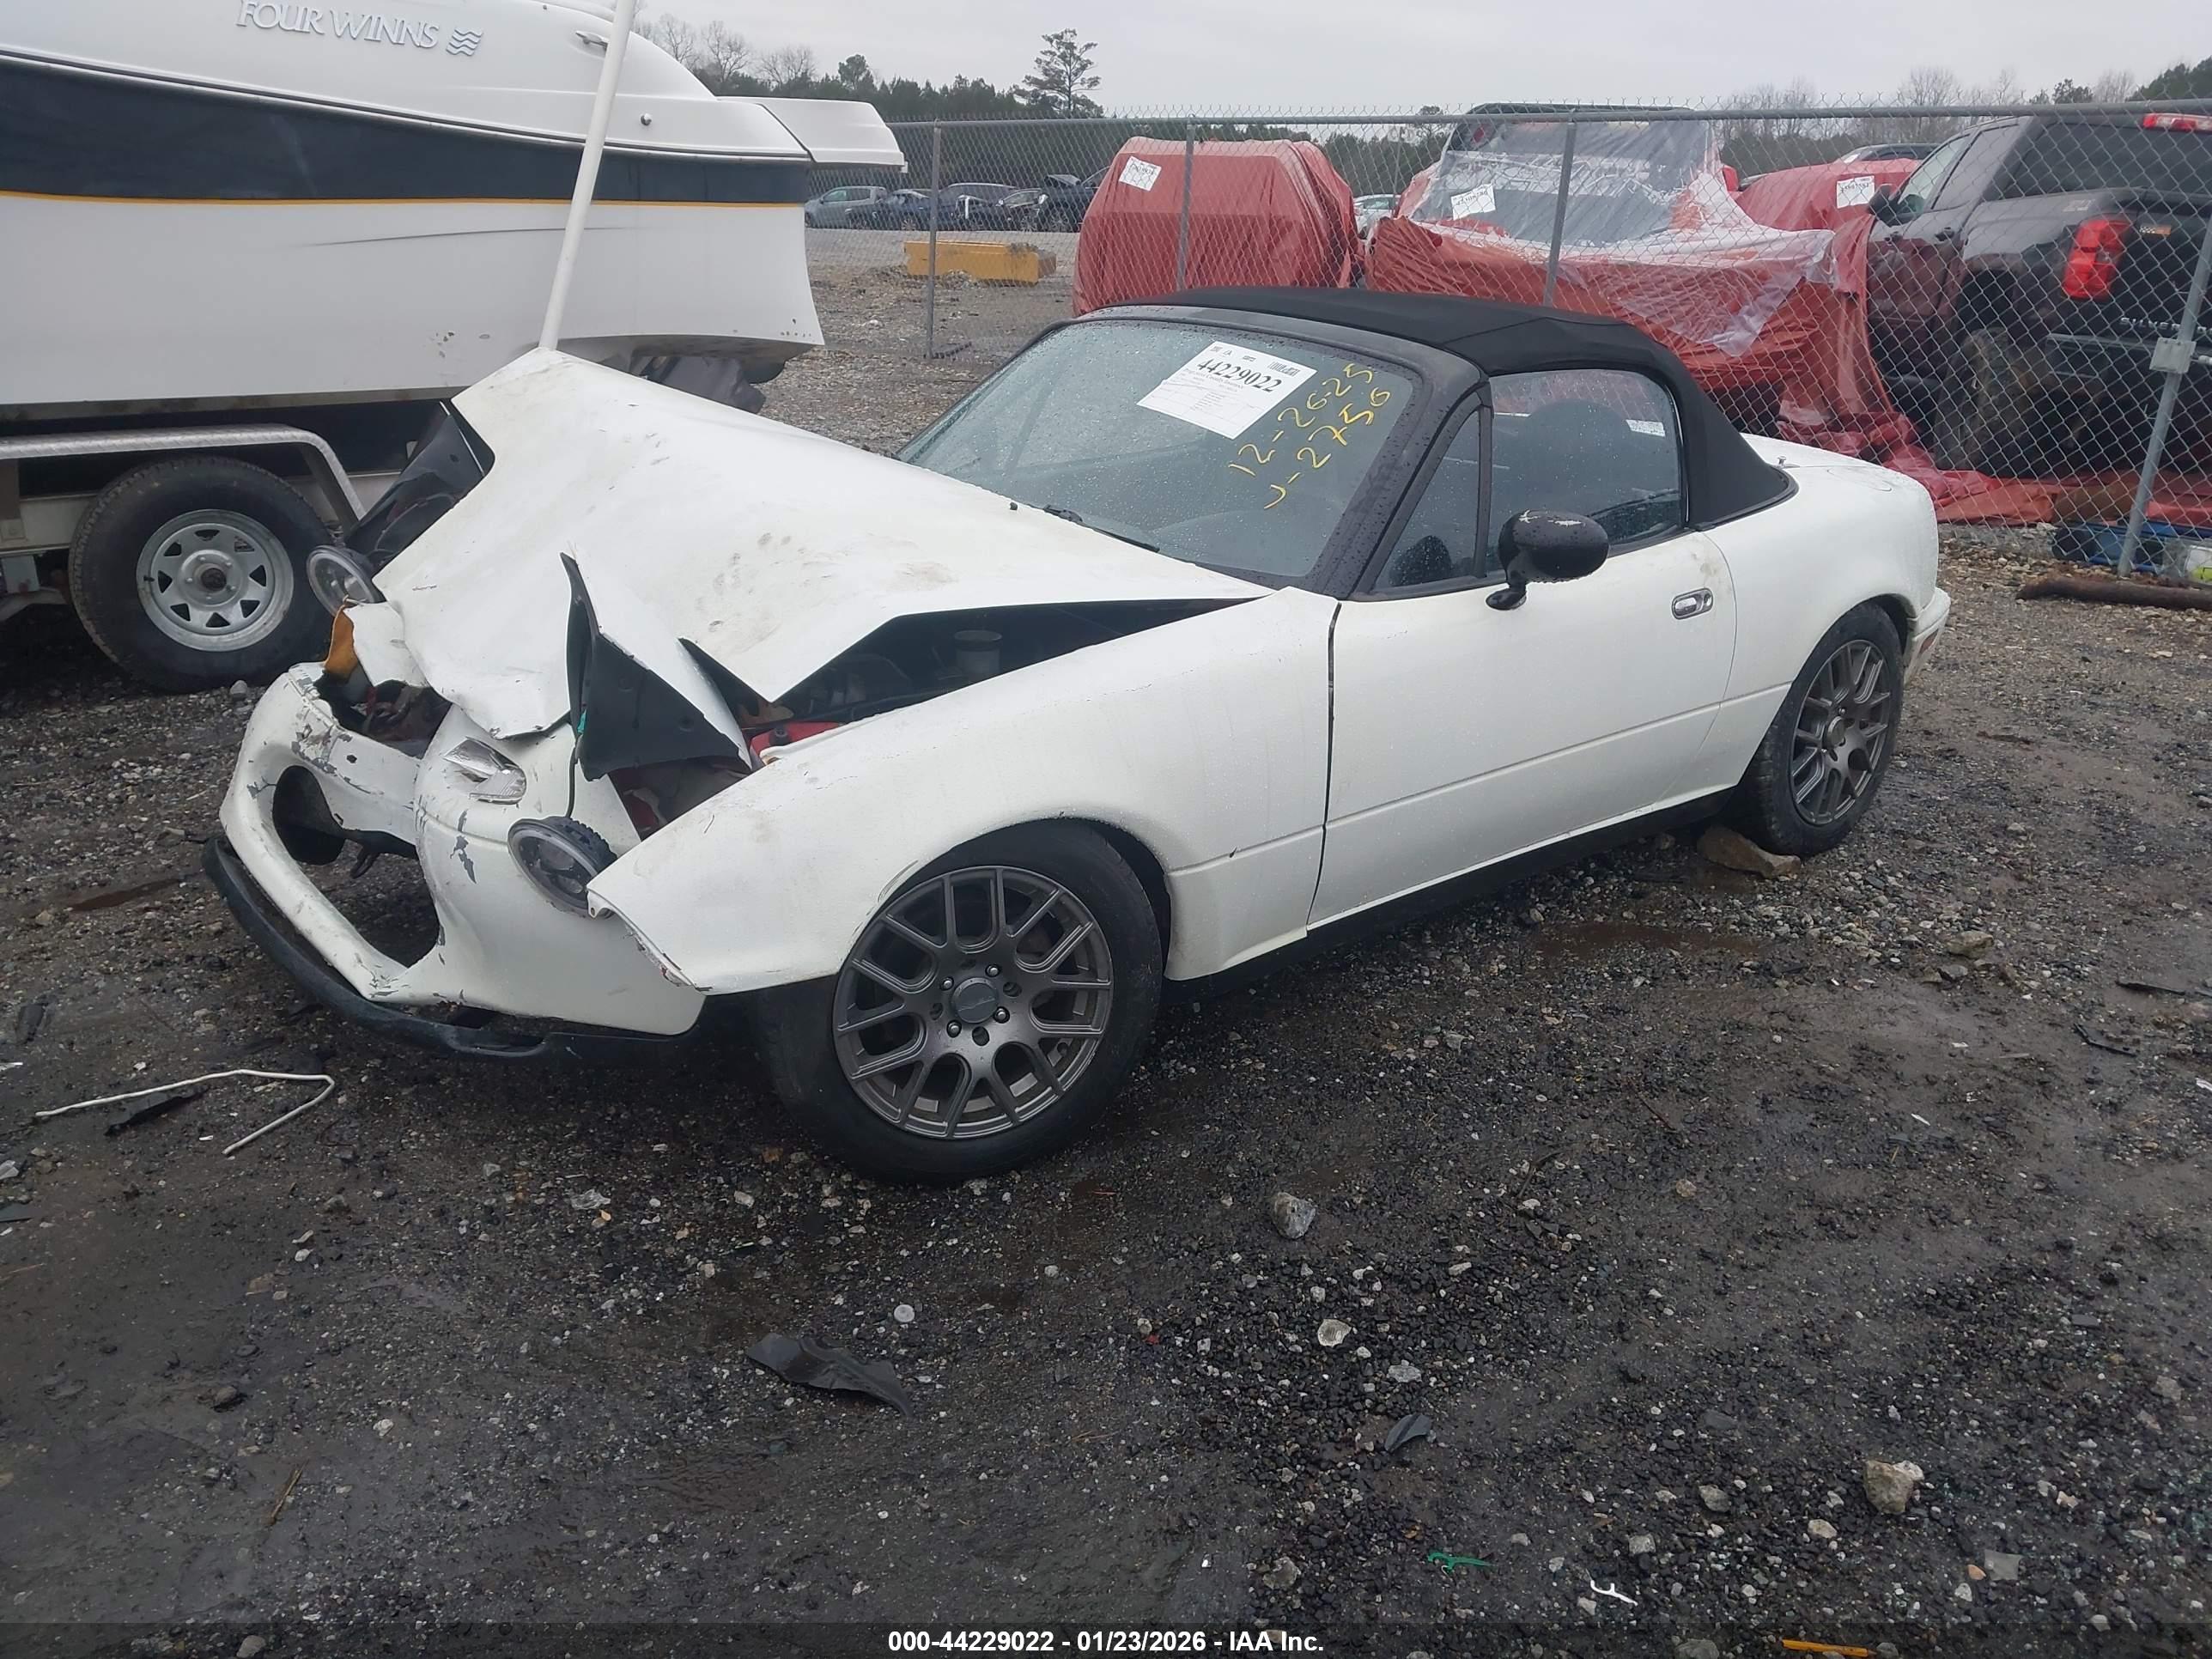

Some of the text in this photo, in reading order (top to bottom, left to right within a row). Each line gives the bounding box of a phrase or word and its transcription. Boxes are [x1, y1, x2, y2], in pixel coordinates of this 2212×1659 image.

[235, 0, 440, 49] FOUR WINNS
[1196, 357, 1283, 392] 44229022
